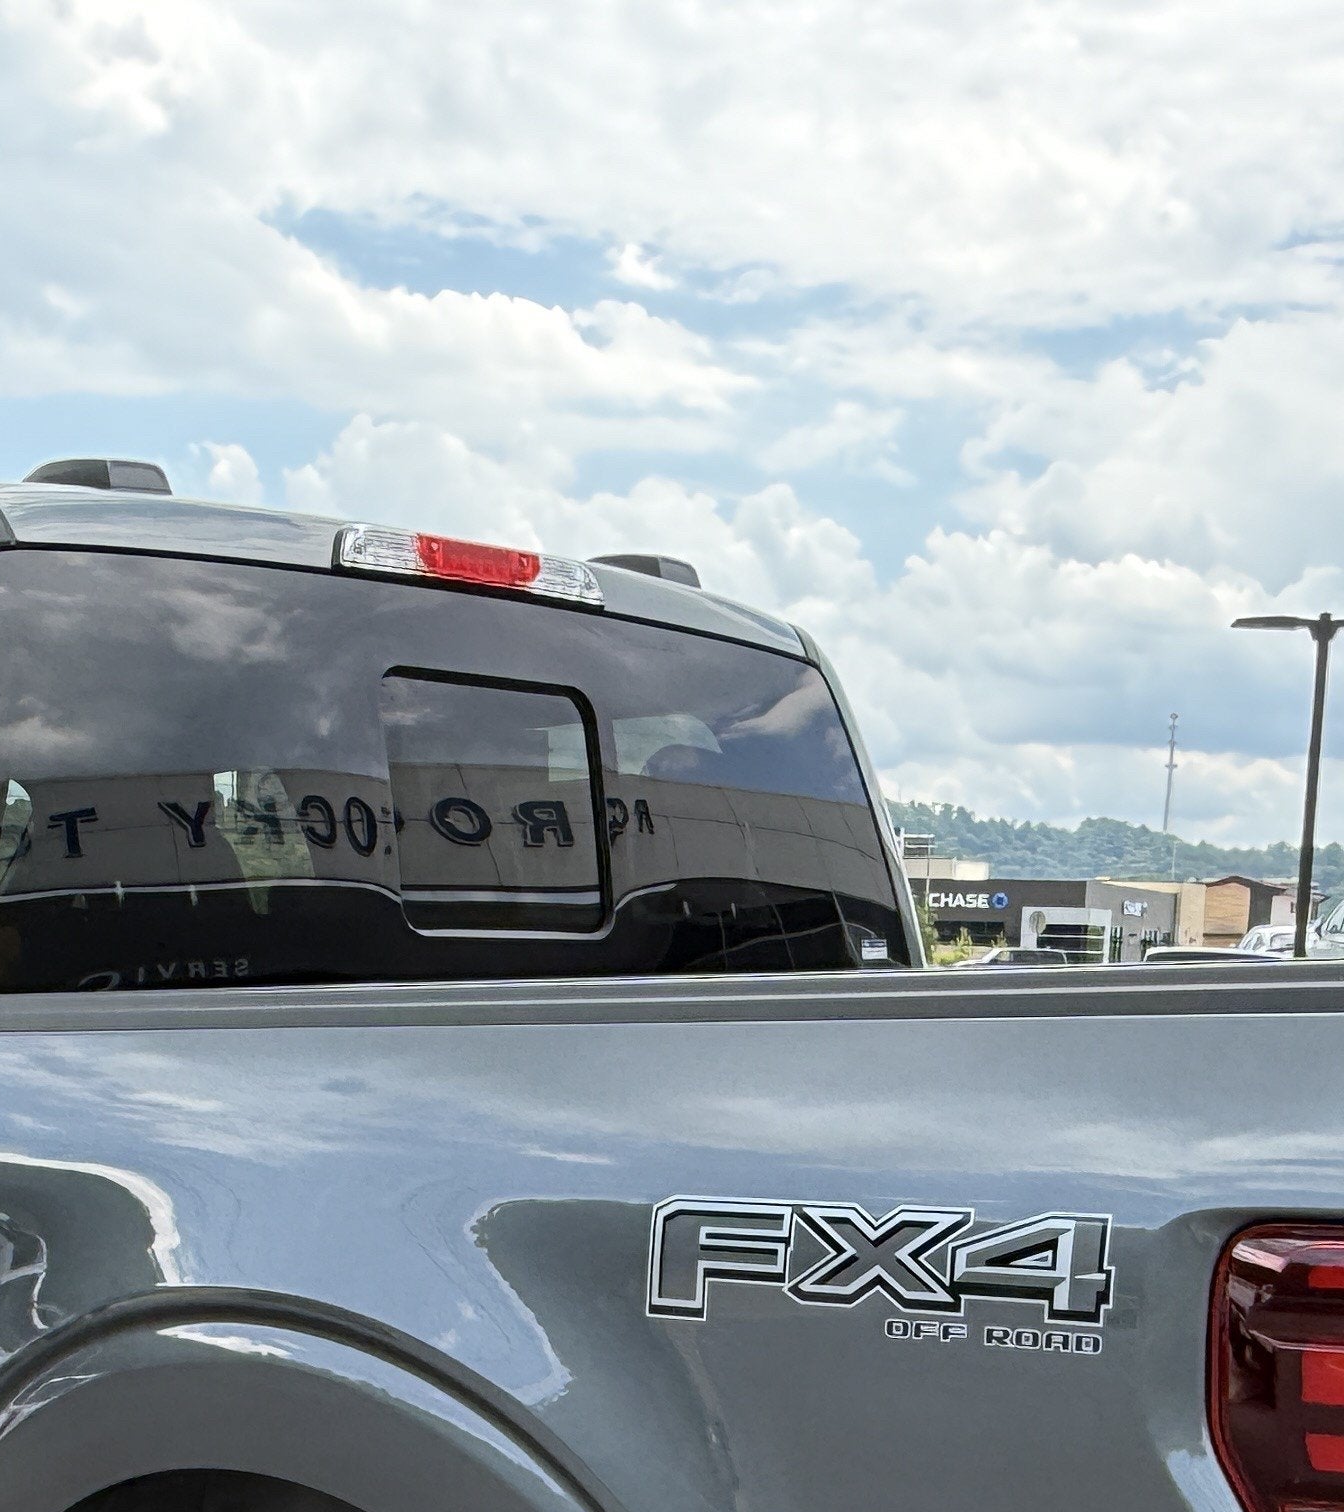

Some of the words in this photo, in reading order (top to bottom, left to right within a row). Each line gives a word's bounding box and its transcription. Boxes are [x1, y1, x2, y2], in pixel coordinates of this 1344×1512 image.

[928, 892, 990, 909] CHASE
[646, 1195, 1116, 1326] FX4
[885, 1318, 968, 1343] OFF
[983, 1325, 1104, 1355] ROAD
